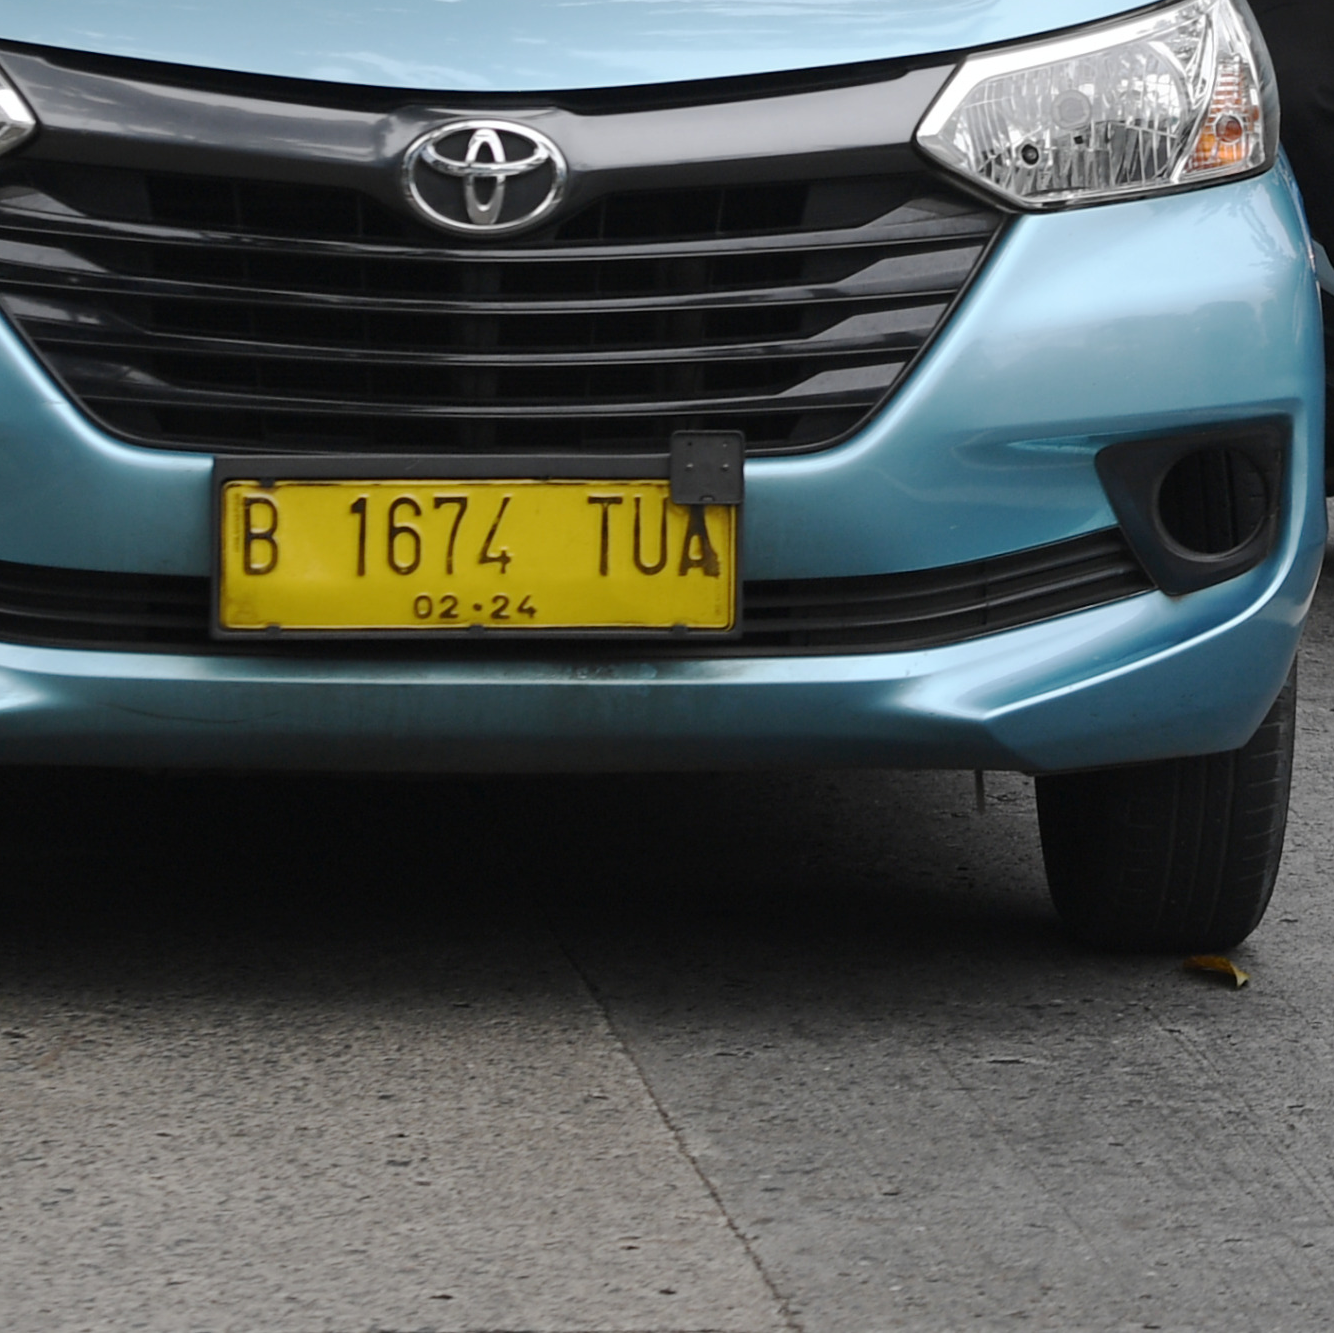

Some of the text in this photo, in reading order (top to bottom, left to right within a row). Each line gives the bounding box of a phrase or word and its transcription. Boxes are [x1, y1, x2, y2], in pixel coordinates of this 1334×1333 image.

[242, 496, 279, 575] B
[350, 496, 513, 576] 1674
[587, 496, 720, 578] TUA
